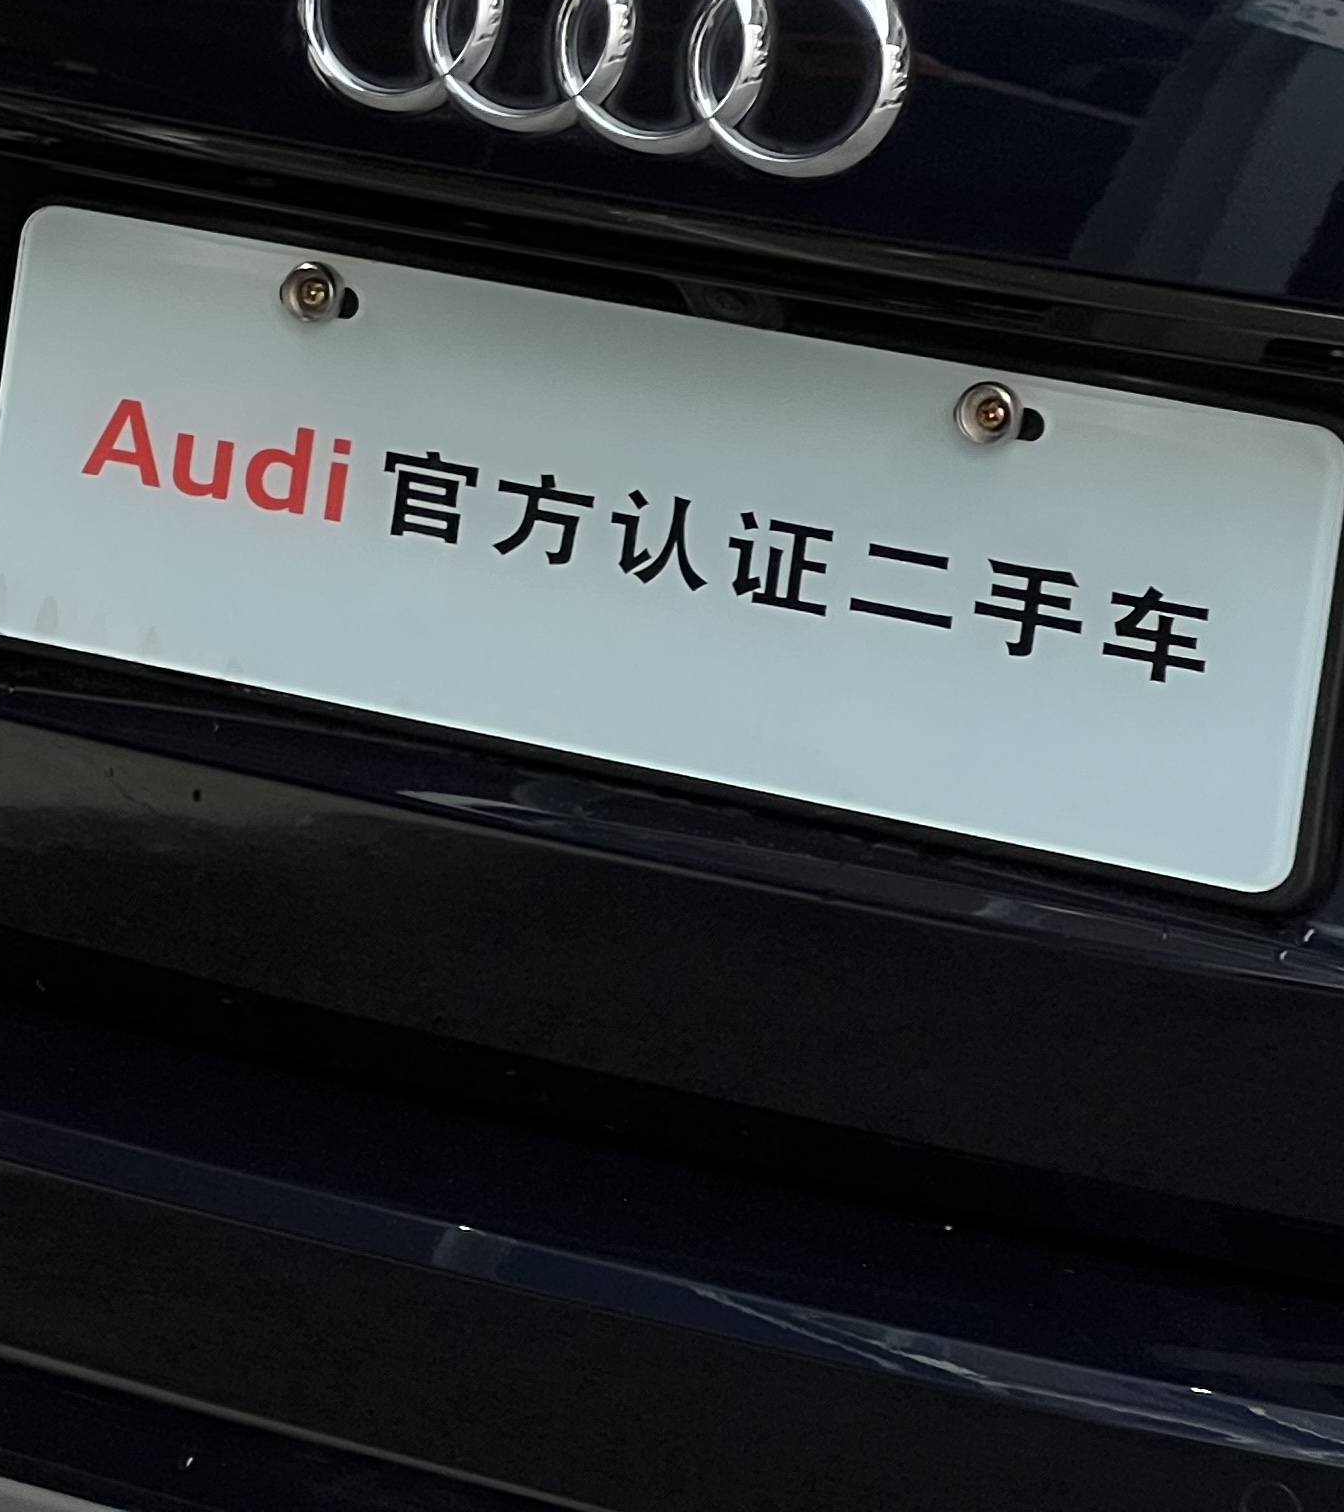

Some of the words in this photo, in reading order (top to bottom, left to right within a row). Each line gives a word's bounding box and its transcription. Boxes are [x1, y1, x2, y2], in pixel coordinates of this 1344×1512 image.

[82, 398, 352, 523] Audi
[382, 450, 1210, 684] 官方认证二手车
